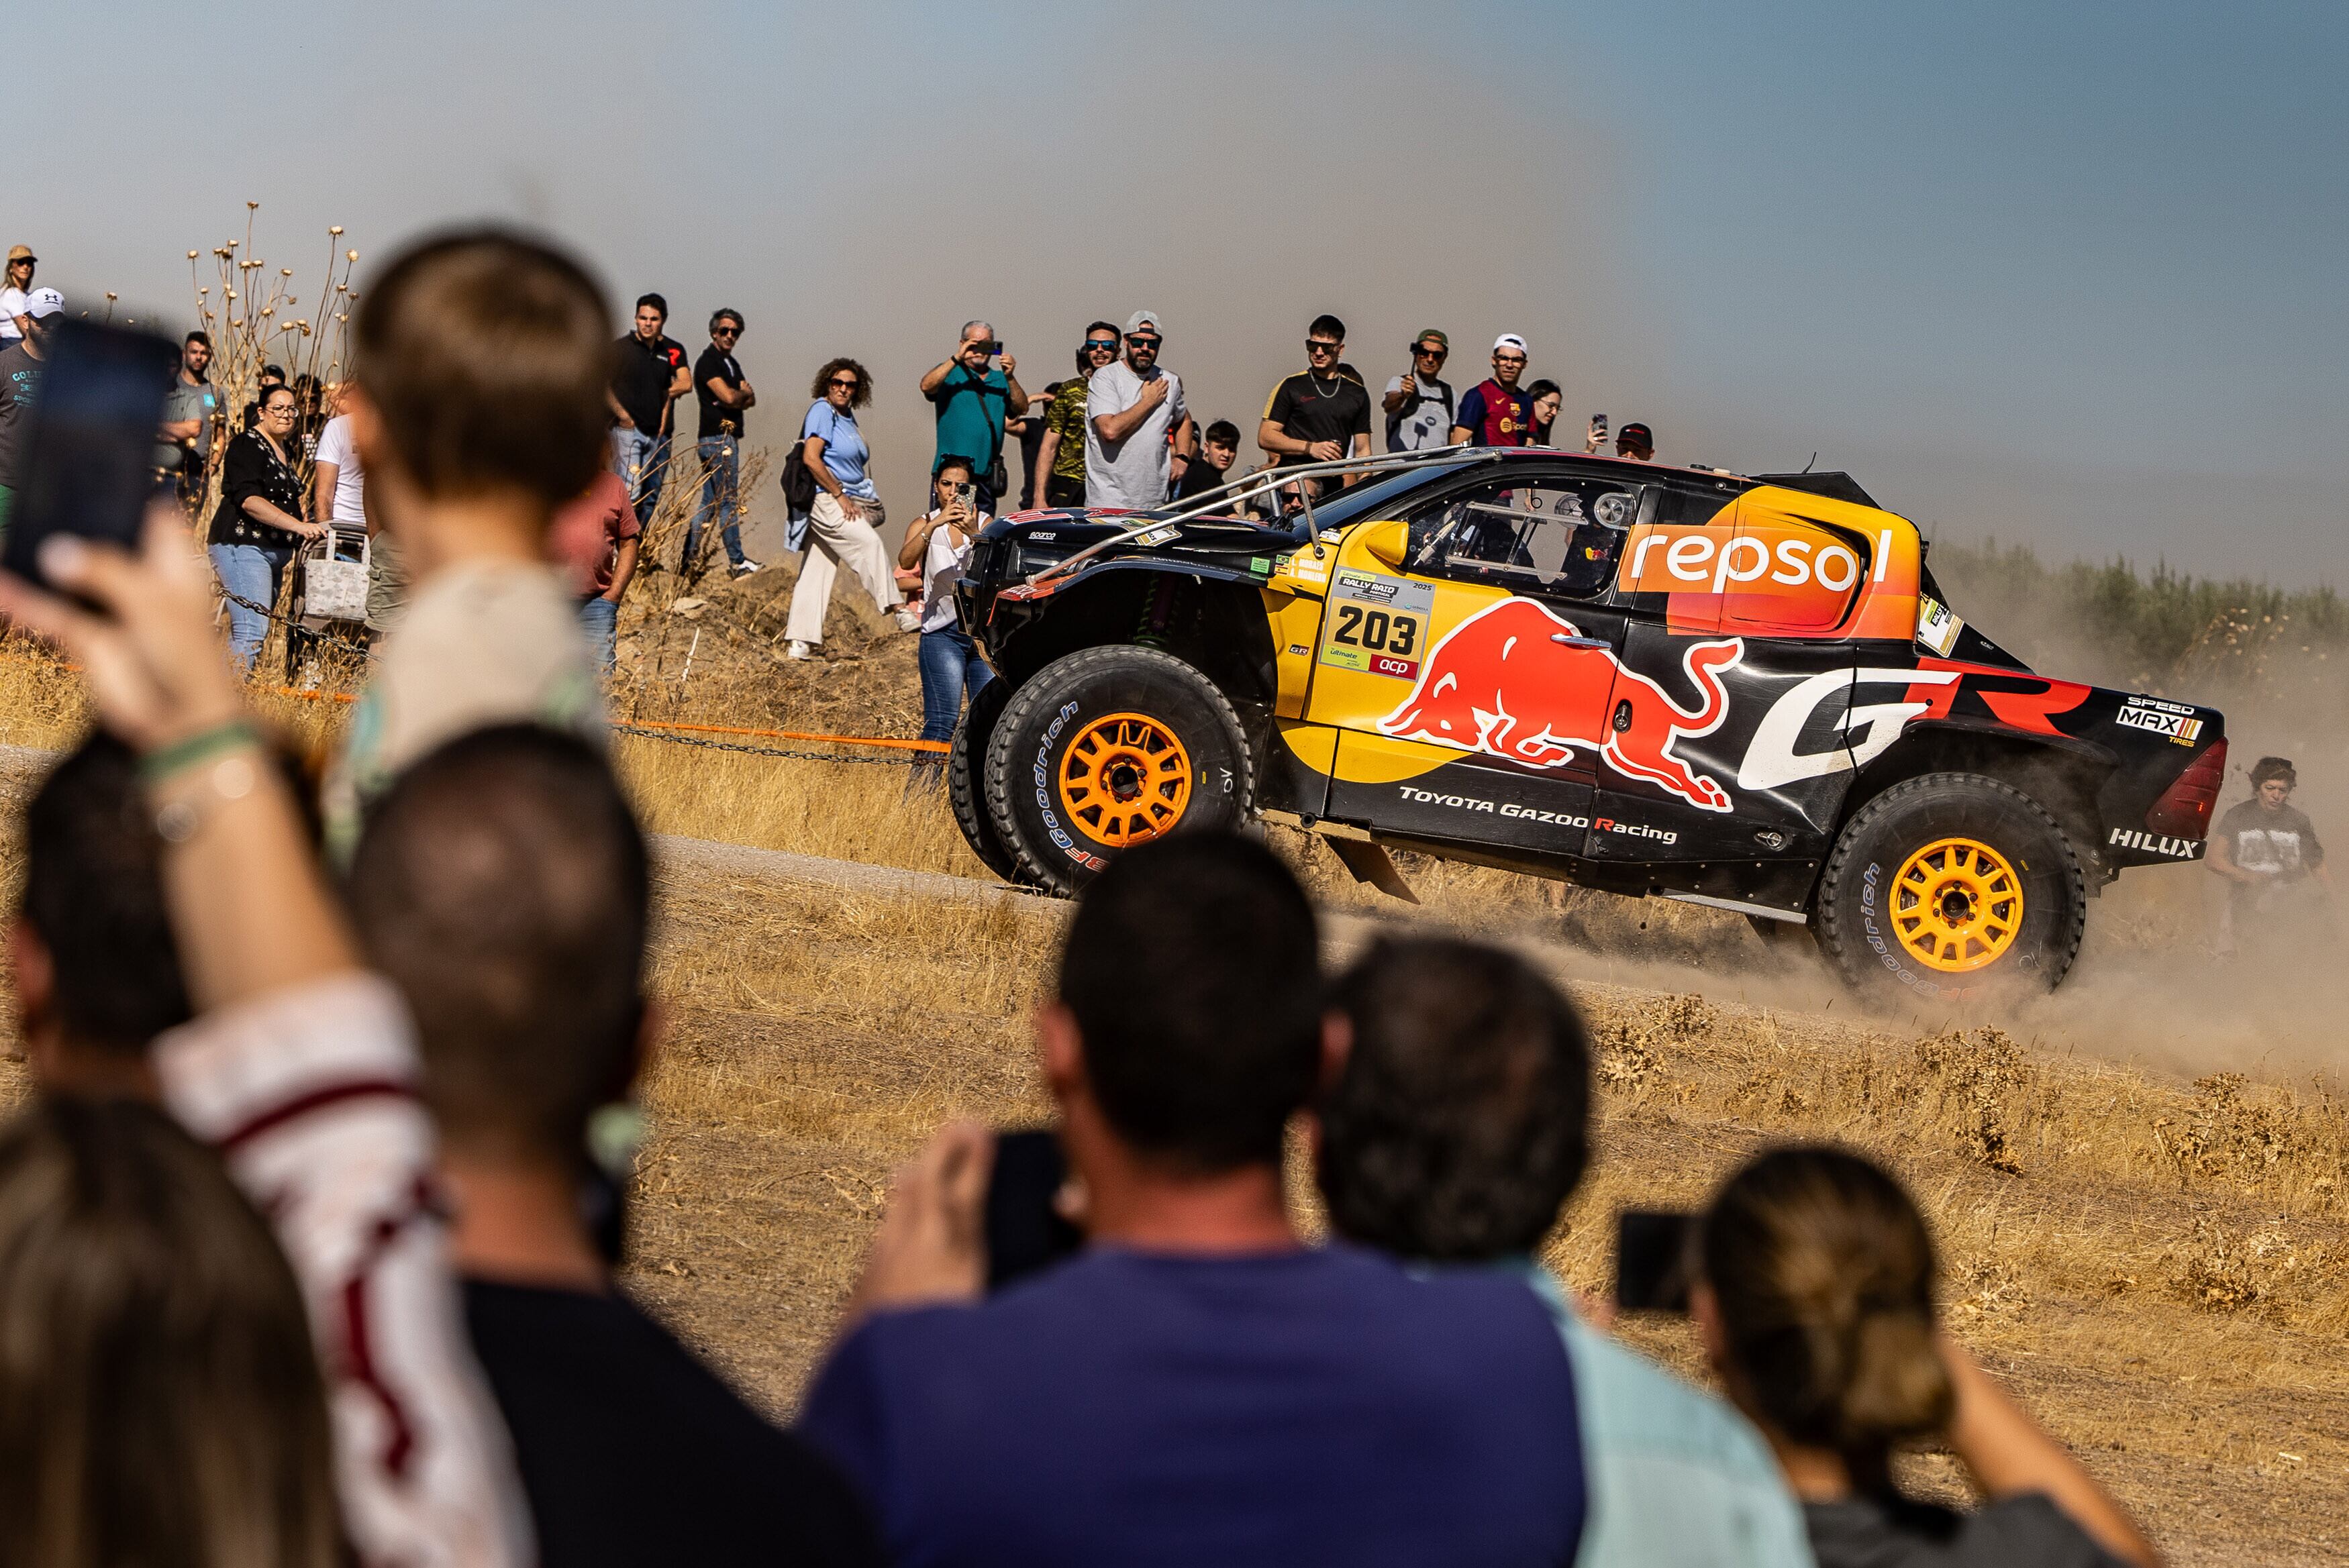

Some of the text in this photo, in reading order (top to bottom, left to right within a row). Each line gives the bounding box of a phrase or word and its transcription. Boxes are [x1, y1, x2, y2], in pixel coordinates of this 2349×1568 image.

[1630, 529, 1892, 593] repsol
[1343, 578, 1395, 594] RALLY RAID
[1413, 583, 1433, 591] 2025
[1334, 605, 1417, 656] 203
[1379, 659, 1408, 674] acp
[2128, 696, 2195, 715] SPEED
[2119, 708, 2181, 733] MAX
[2168, 736, 2195, 747] TIRES
[1399, 786, 1678, 845] TOYOTA GAZOO Racing
[2109, 828, 2199, 858] HILUX
